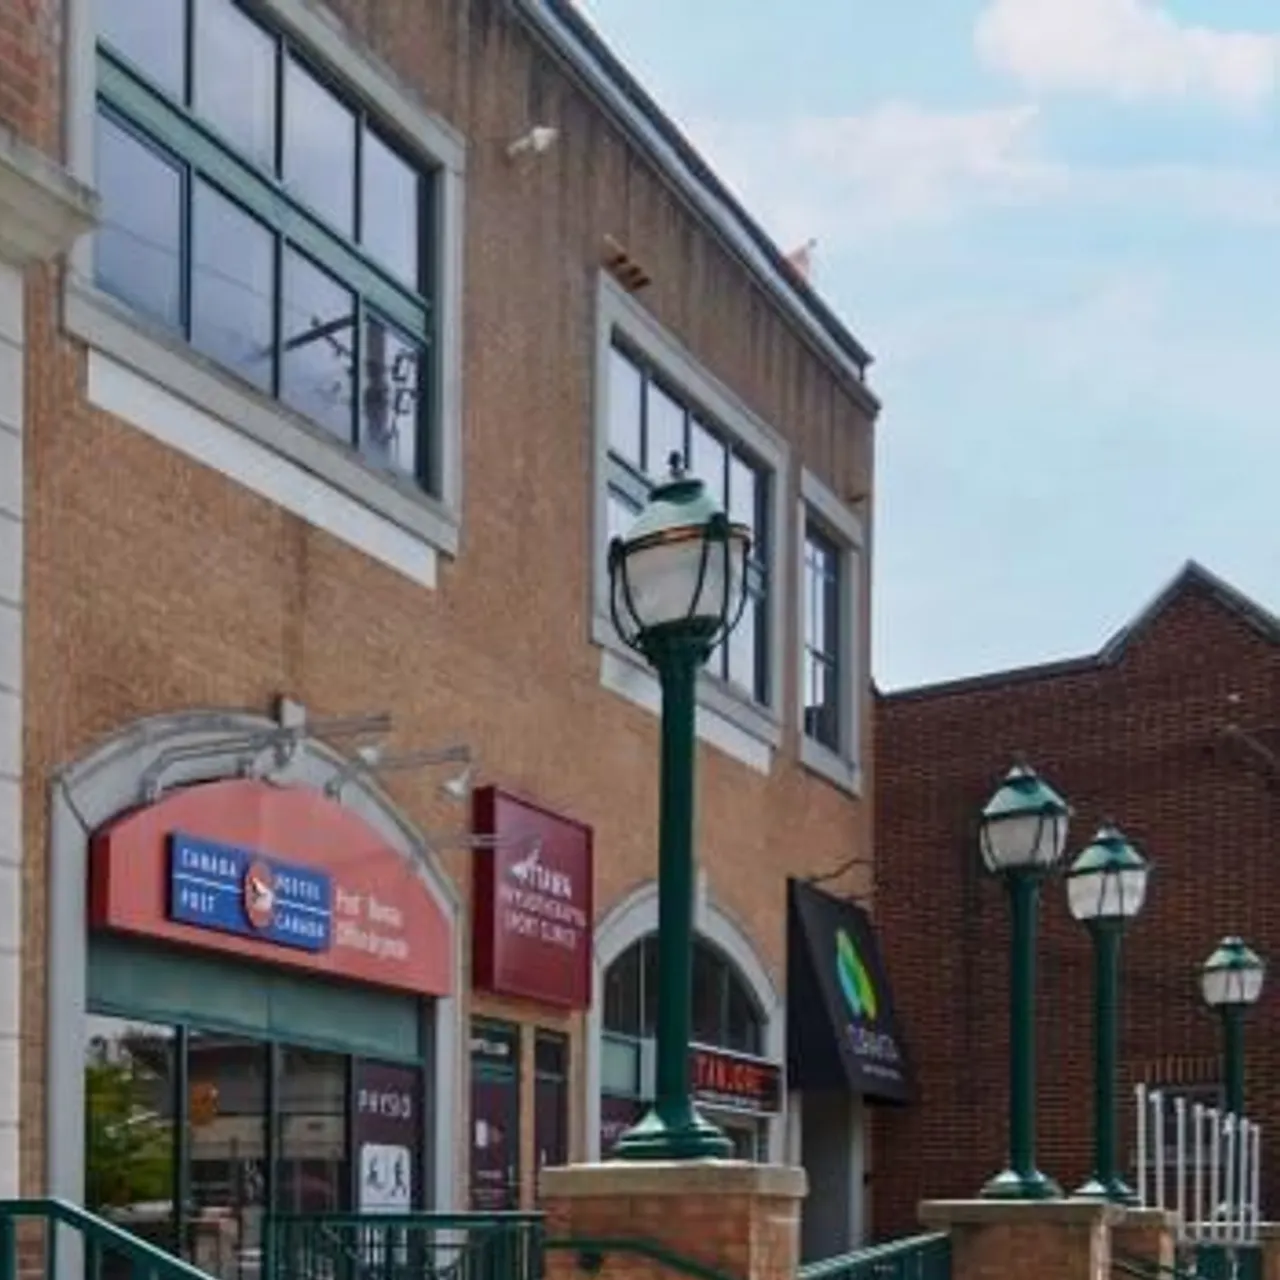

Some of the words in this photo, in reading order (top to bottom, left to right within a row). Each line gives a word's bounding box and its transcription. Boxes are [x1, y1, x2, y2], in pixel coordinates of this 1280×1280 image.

[181, 847, 238, 877] CANADA
[181, 887, 215, 913] POST
[274, 912, 325, 938] CANADA
